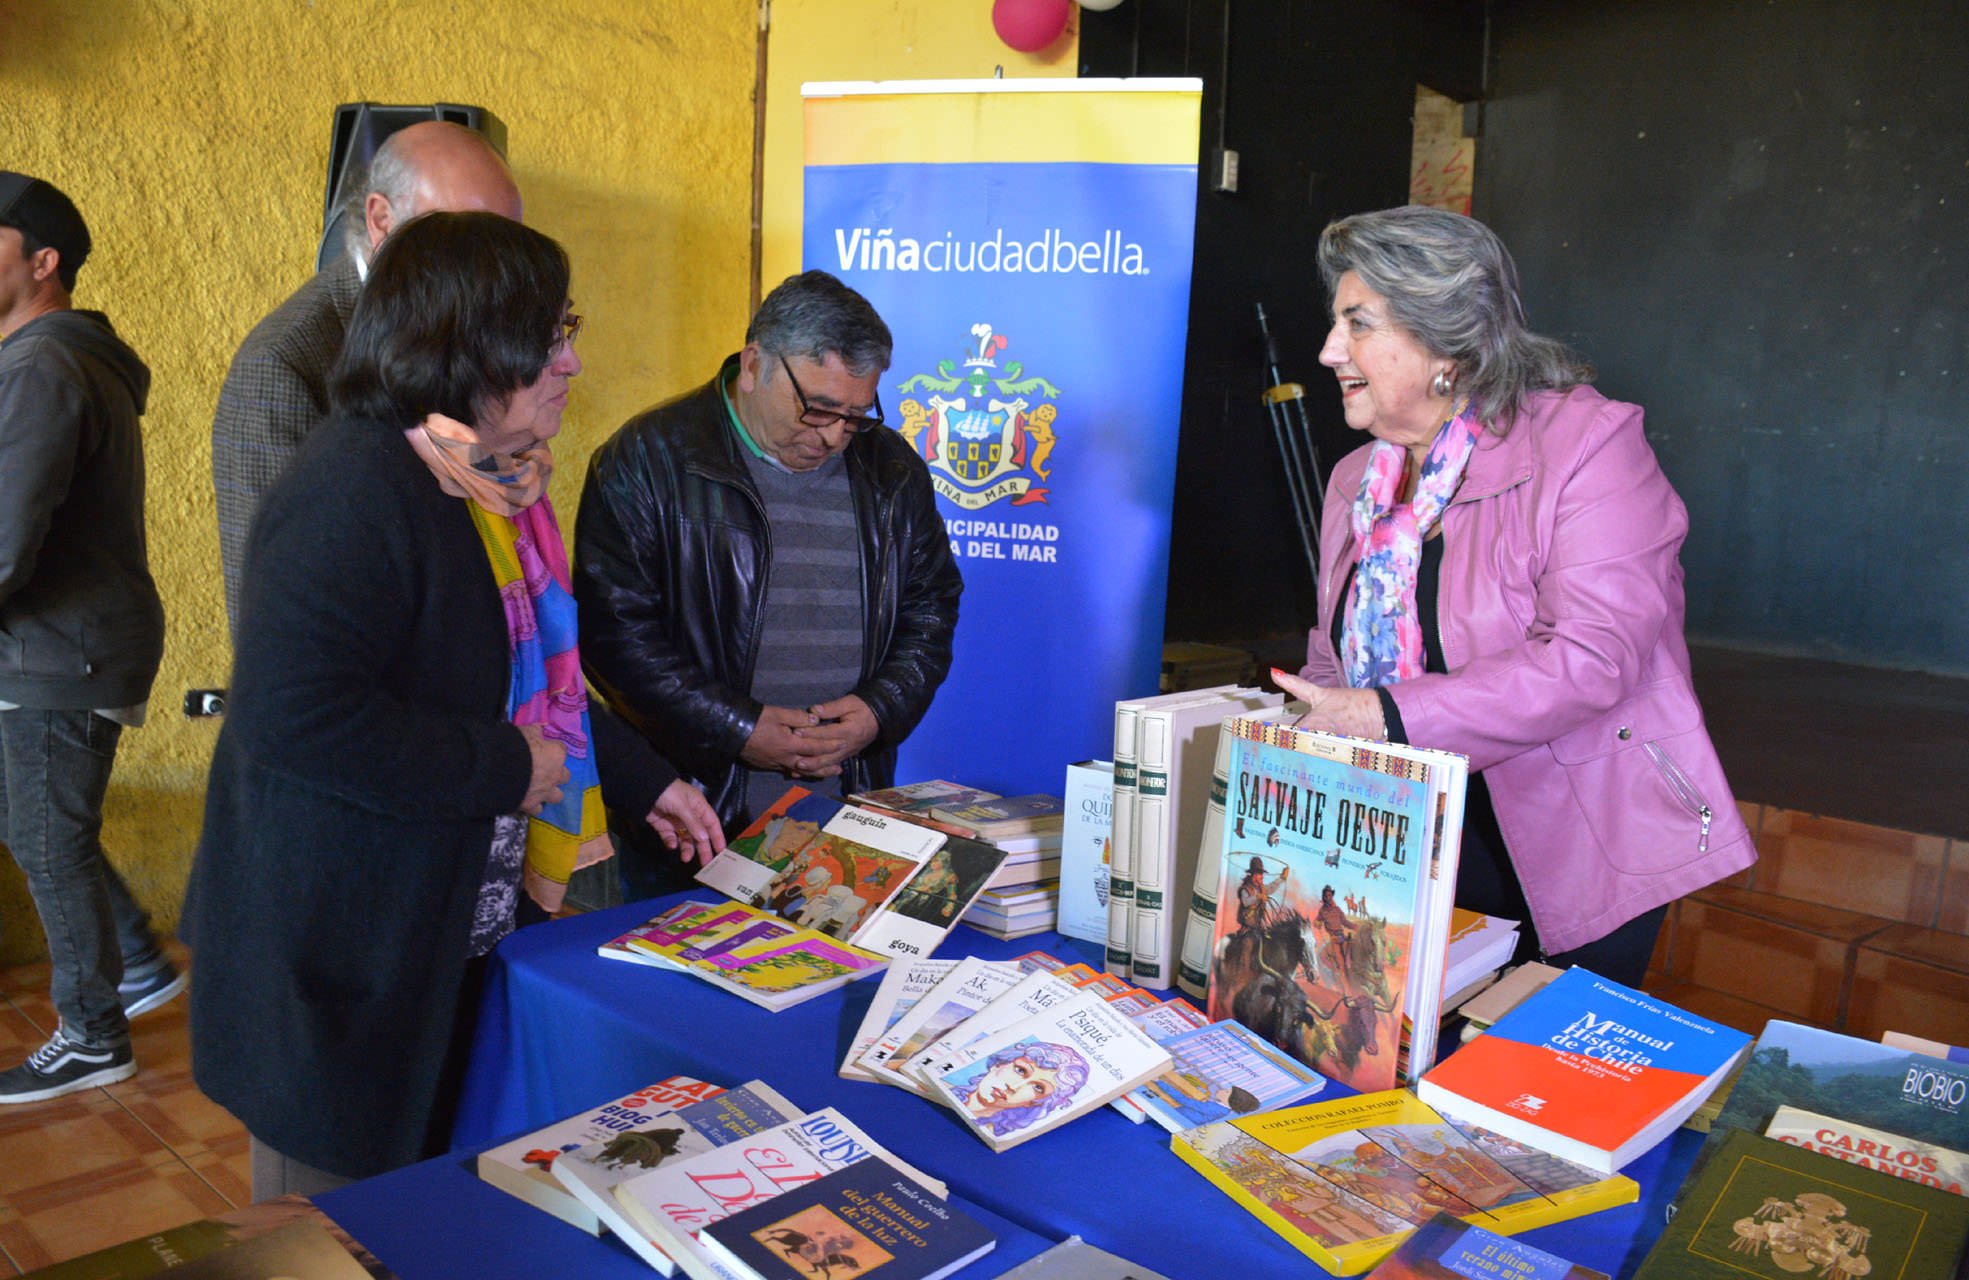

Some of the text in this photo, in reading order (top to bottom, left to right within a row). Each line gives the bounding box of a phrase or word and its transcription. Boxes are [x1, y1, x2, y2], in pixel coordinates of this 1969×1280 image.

[984, 481, 1018, 502] MAR
[943, 519, 1060, 542] ICIPALIDAD
[967, 541, 1006, 560] DEL
[1012, 544, 1057, 563] MAR
[1242, 752, 1410, 808] El fascinante mundo del
[841, 809, 888, 831] gauguin
[1082, 799, 1113, 817] QUIJ
[1237, 771, 1410, 866] SALVAJE OESTE
[888, 937, 921, 956] goya
[1592, 981, 1637, 1005] Francisco
[1664, 1010, 1716, 1035] Valenzuela
[1561, 1022, 1653, 1067] Historia
[1574, 1011, 1675, 1052] Manual
[1613, 1035, 1631, 1046] de
[1551, 1033, 1644, 1076] de Chile
[1555, 1056, 1581, 1071] hasta
[1580, 1057, 1632, 1083] Prehistoria
[633, 1085, 701, 1109] GUT
[1902, 1068, 1967, 1105] BIOBIO
[1815, 1129, 1938, 1174] CARLOS
[872, 1191, 931, 1230] Manual
[892, 1181, 951, 1222] Paulo Coelho
[839, 1204, 899, 1247] de la luz
[842, 1188, 928, 1249] del guerrero
[1461, 1249, 1501, 1273] verano
[1481, 1244, 1536, 1274] El último
